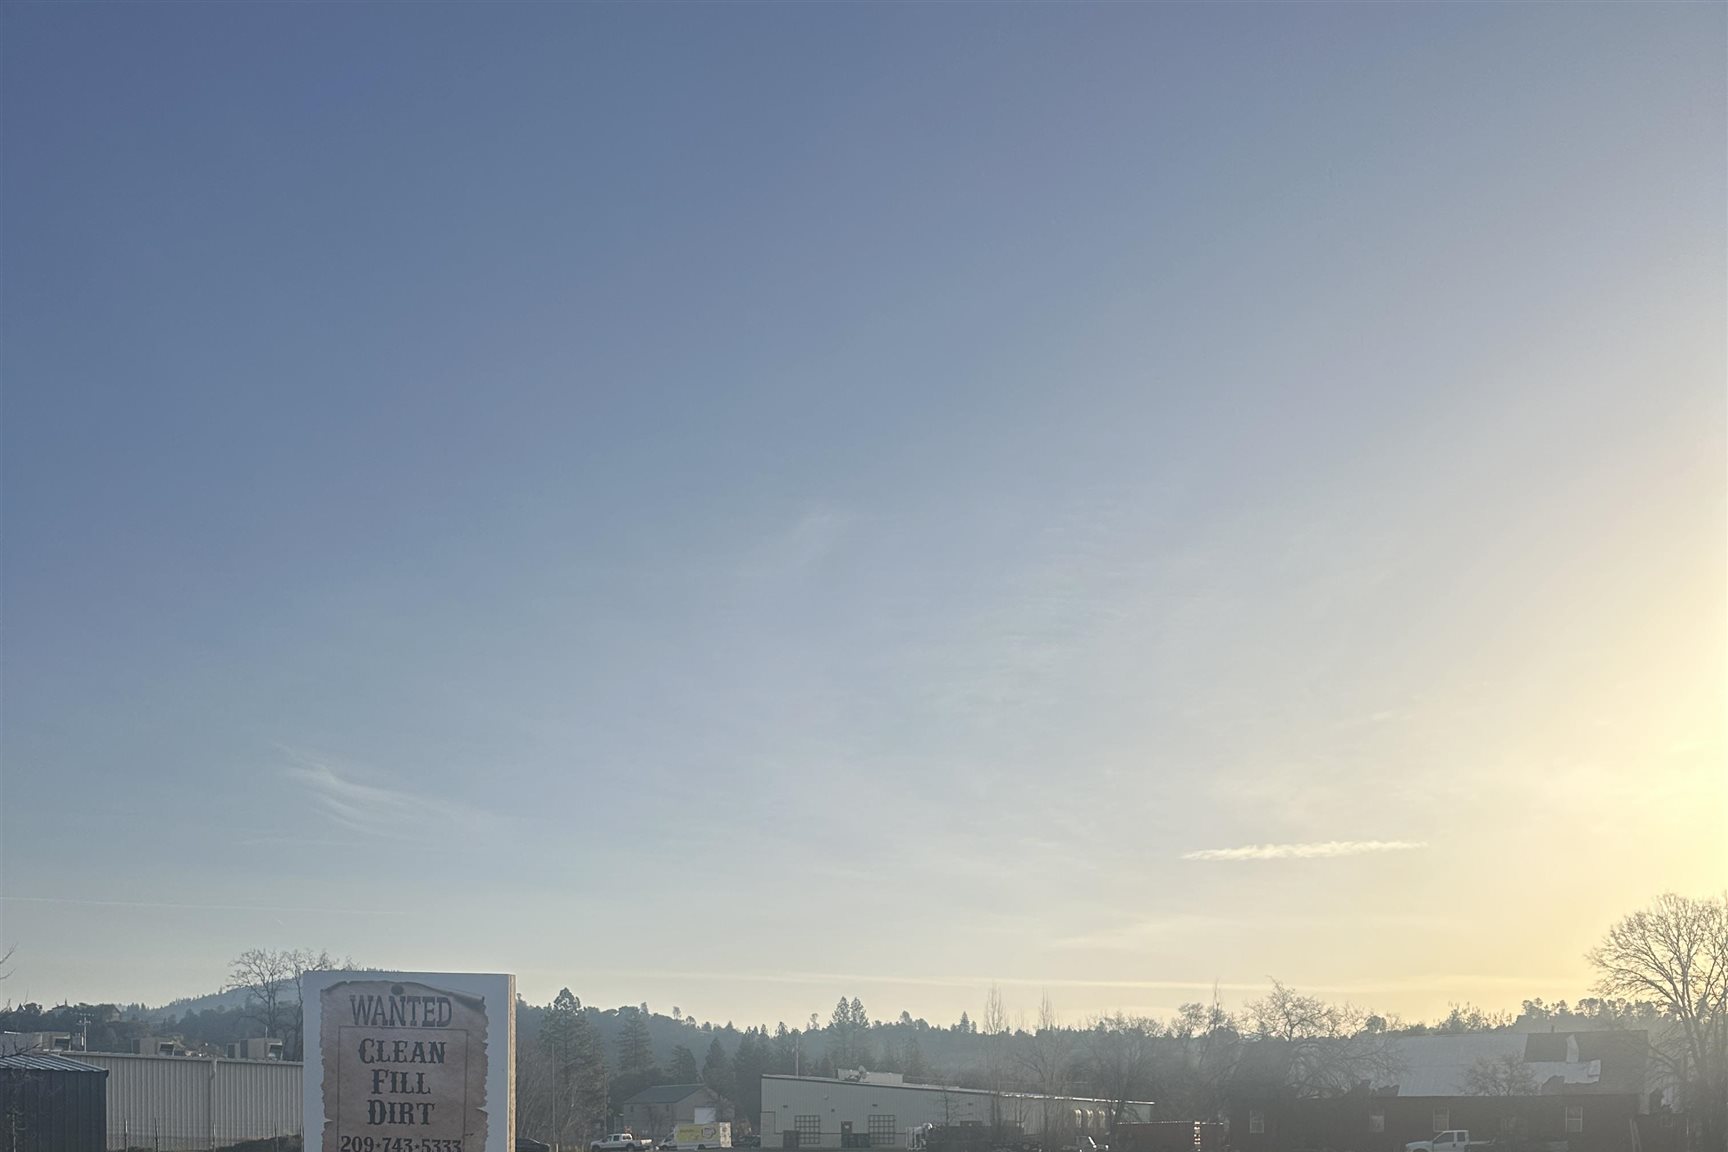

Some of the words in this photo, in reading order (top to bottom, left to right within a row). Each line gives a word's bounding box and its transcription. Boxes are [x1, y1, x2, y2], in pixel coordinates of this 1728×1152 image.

[350, 995, 452, 1027] WANTED
[358, 1038, 446, 1064] CLEAN
[371, 1069, 431, 1095] FILL
[367, 1099, 435, 1126] DIRT
